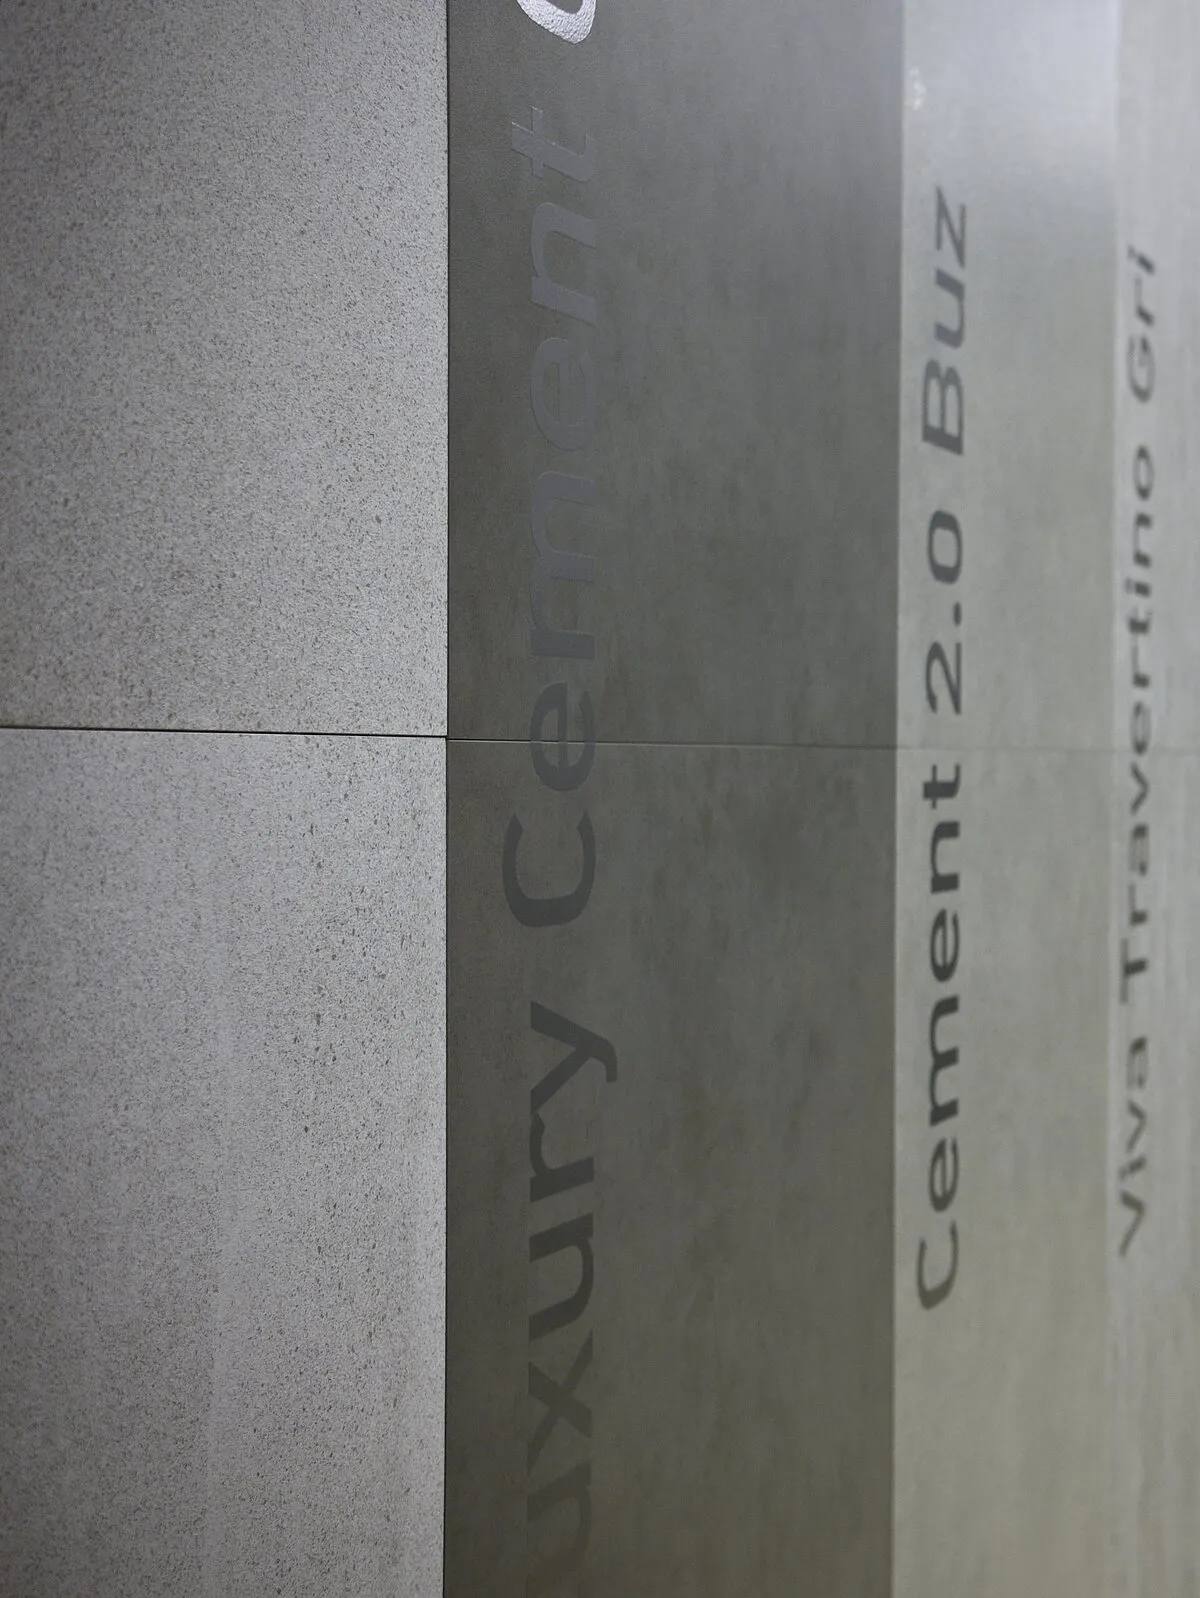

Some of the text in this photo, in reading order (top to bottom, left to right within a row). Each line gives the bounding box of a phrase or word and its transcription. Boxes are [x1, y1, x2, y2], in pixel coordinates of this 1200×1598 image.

[502, 105, 598, 928] Cement
[917, 184, 967, 1310] Cement 2.0 Buz
[1119, 244, 1156, 1258] Viva Travertino Gri
[526, 1000, 618, 1598] uxury
